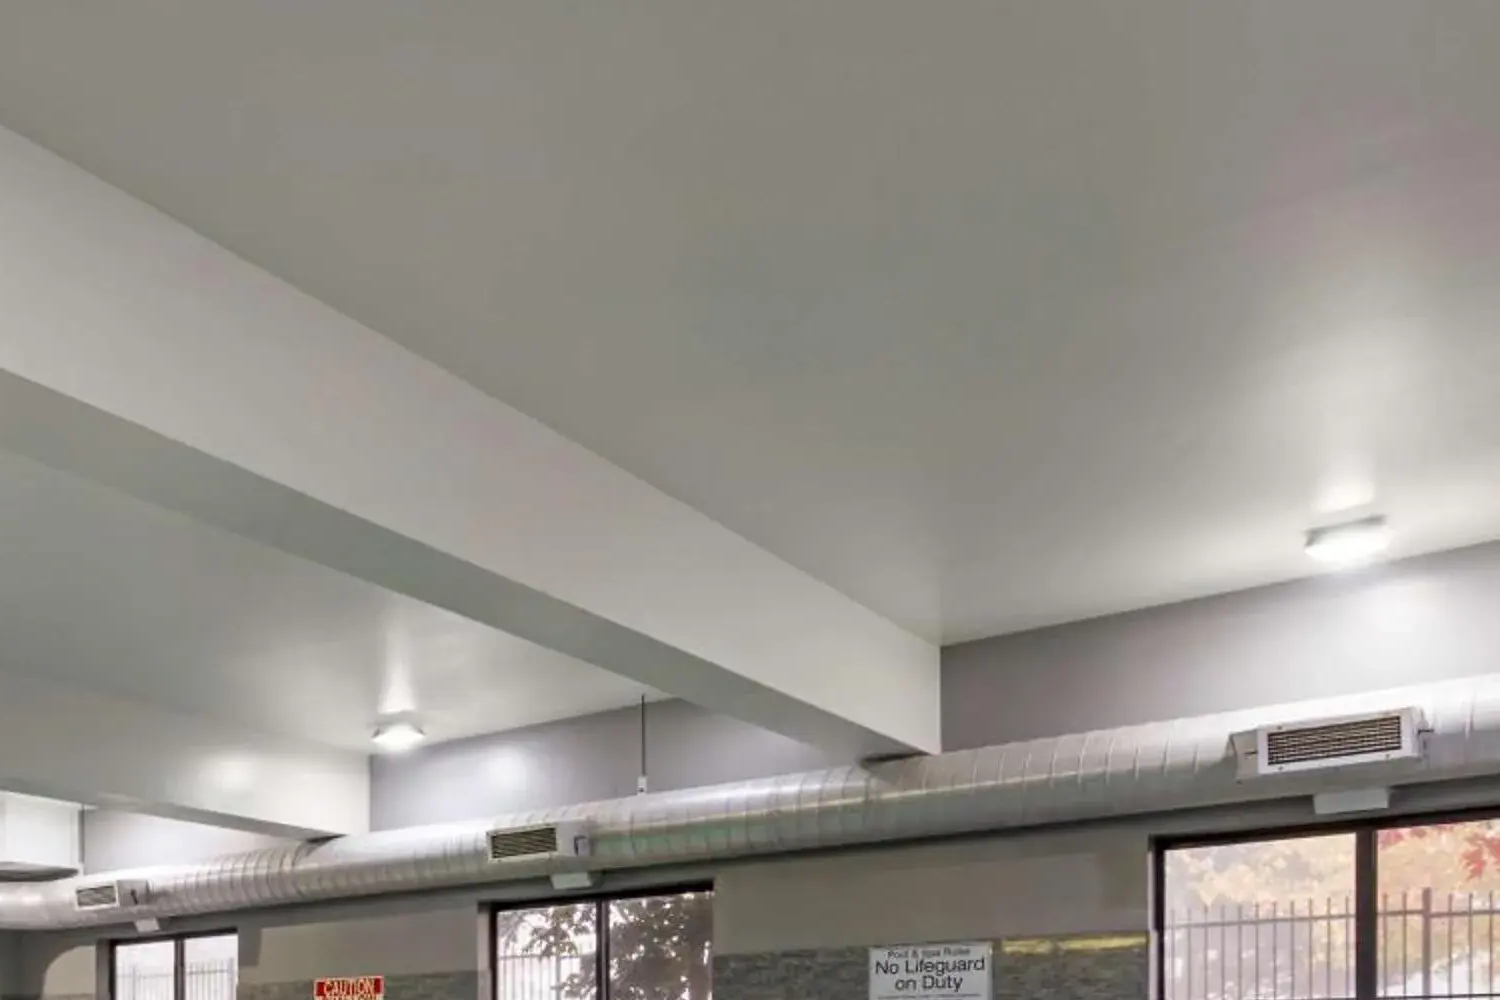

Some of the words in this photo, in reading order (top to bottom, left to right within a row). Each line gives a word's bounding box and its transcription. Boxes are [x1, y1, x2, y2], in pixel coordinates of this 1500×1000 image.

[875, 959, 900, 974] No
[905, 956, 985, 976] Lifeguard
[323, 978, 376, 996] CAUTION
[895, 979, 917, 991] on
[922, 975, 963, 992] Duty
